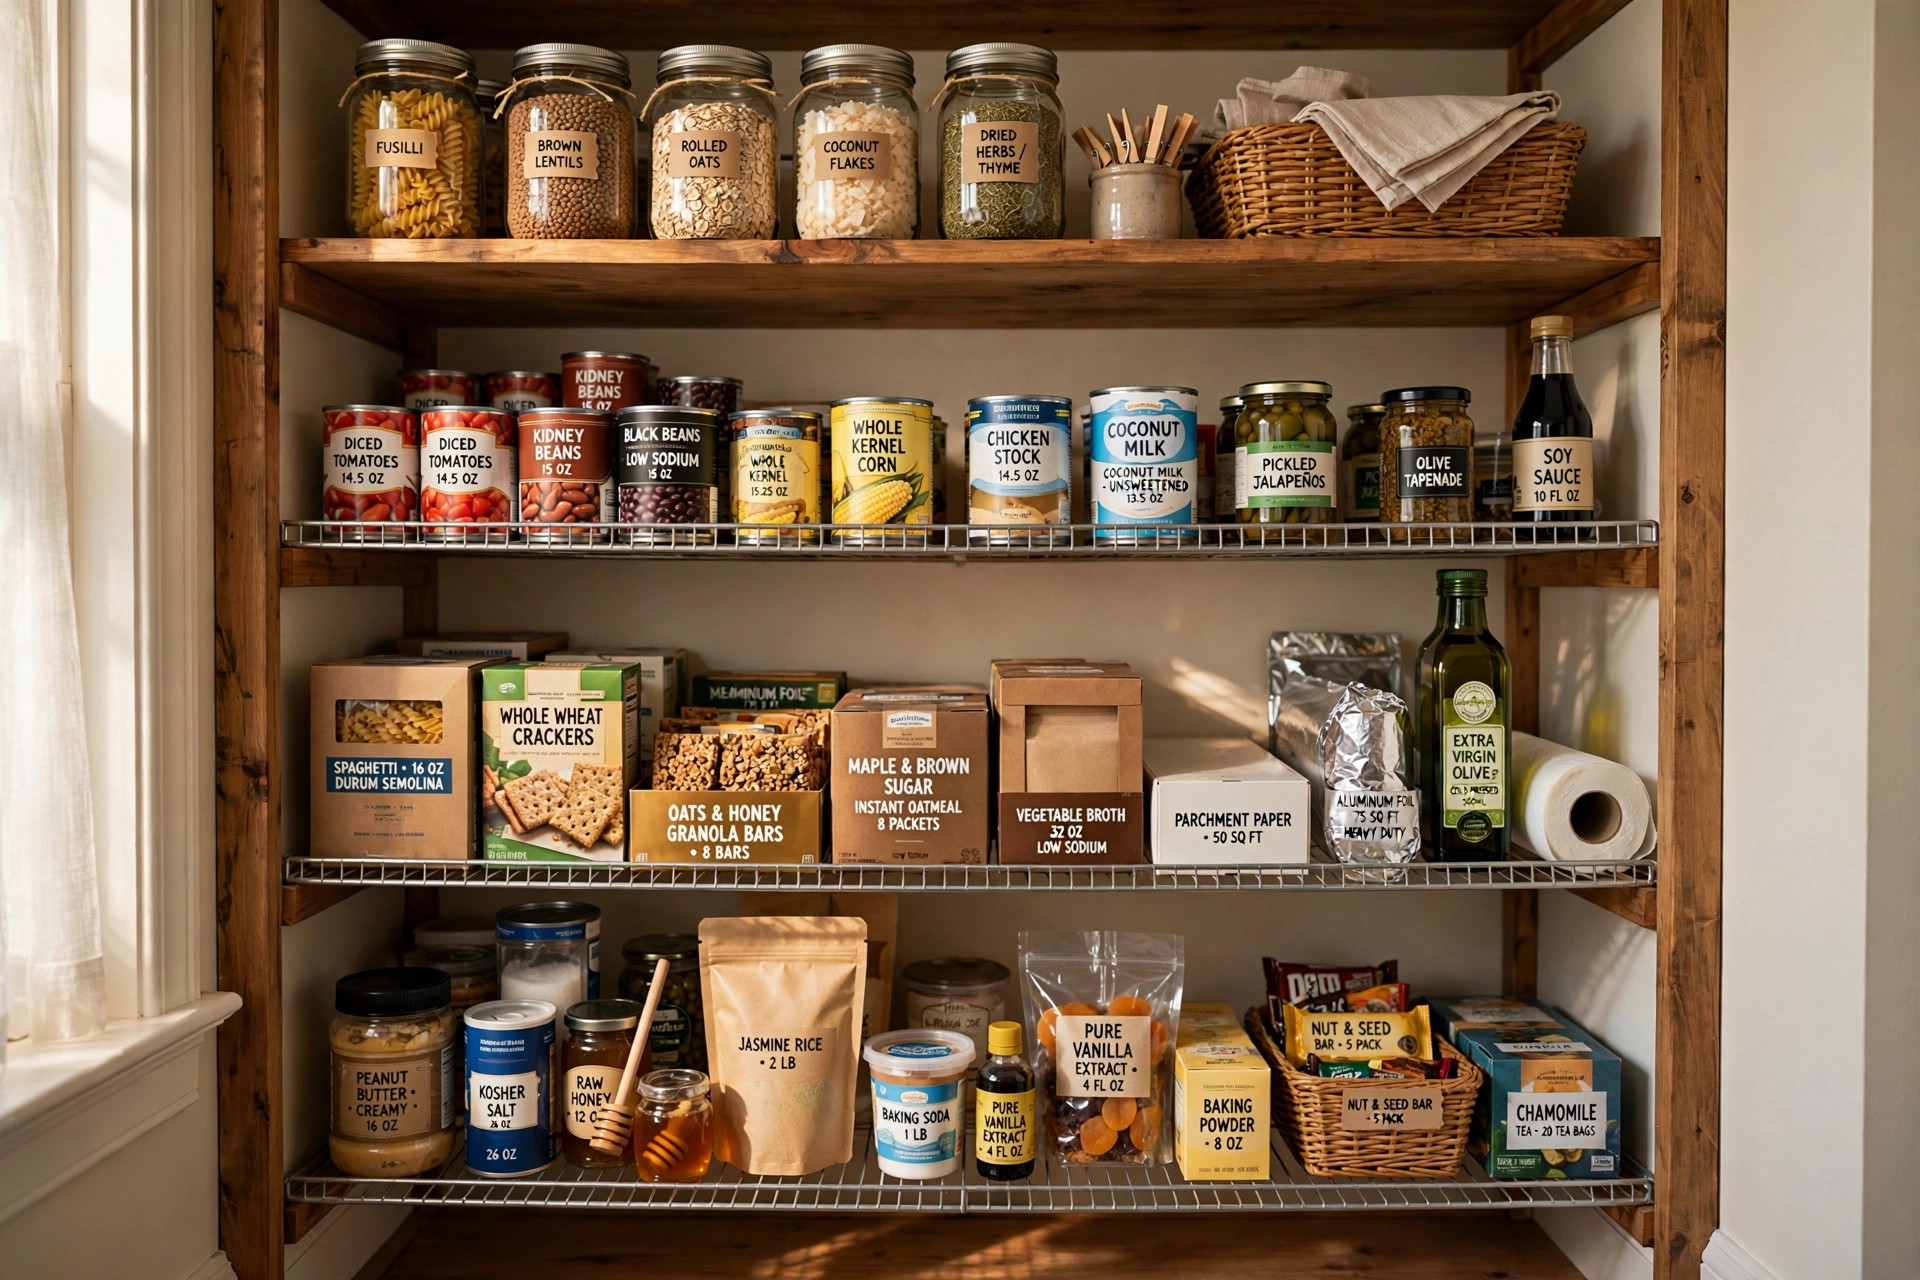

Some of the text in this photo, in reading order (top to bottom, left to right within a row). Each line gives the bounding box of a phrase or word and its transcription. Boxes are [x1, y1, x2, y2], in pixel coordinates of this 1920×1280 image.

[981, 129, 1017, 142] DRIED
[376, 141, 423, 155] FUSILLI
[538, 140, 581, 152] BROWN
[682, 140, 727, 153] ROLLED
[824, 141, 879, 153] COCONUT
[536, 156, 583, 169] LENTILS
[689, 155, 720, 169] OATS
[830, 156, 875, 170] FLAKES
[978, 161, 1021, 174] THYME
[576, 370, 624, 384] KIDNEY
[578, 385, 621, 399] BEANS
[854, 420, 902, 435] WHOLE
[1108, 421, 1180, 438] COCONUT
[533, 429, 584, 443] KIDNEY
[624, 427, 700, 442] BLACK BEANS
[988, 430, 1049, 445] CHICKEN
[345, 438, 382, 450] DICED
[440, 438, 476, 450] DICED
[852, 439, 905, 454] KERNEL
[1125, 440, 1166, 456] MILK
[535, 446, 581, 460] BEANS
[995, 450, 1041, 464] STOCK
[1544, 448, 1572, 464] SOY
[334, 455, 398, 468] TOMATOES
[429, 455, 492, 468] TOMATOES
[627, 453, 699, 467] LOW SODIUM
[858, 457, 896, 472] CORN
[1263, 458, 1317, 471] PICKLED
[1416, 456, 1451, 470] OLIVE
[542, 464, 572, 475] 15 OZ
[660, 469, 672, 479] OZ
[999, 470, 1039, 481] 14.5 OZ
[1104, 467, 1183, 479] COCONUT MILK
[342, 473, 384, 484] 14.5 OZ
[437, 473, 478, 484] 14.5 OZ
[750, 471, 788, 482] KERNEL
[1253, 472, 1325, 489] JALAPEÑOS
[1404, 473, 1462, 488] TAPENADE
[1534, 469, 1581, 484] SAUCE
[776, 487, 788, 496] OZ
[1534, 490, 1579, 502] 10 FL OZ
[1150, 494, 1163, 503] OZ
[500, 708, 603, 724] WHOLE WHEAT
[513, 728, 594, 745] CRACKERS
[1454, 734, 1495, 747] EXTRA
[1453, 751, 1495, 763] VIRGIN
[334, 762, 444, 775] SPAGHETTI 16 OZ
[849, 758, 970, 774] MAPLE & BROWN
[335, 777, 443, 790] DURUM SEMOLINA
[885, 778, 933, 794] SUGAR
[855, 801, 962, 814] INSTANT OATMEAL
[1337, 795, 1393, 808] ALUMINUM
[668, 804, 781, 821] OATS & HONEY
[1017, 808, 1126, 822] VEGETABLE BROTH
[1370, 810, 1383, 823] SQ
[1388, 811, 1399, 824] FT
[878, 817, 939, 830] 8 PACKETS
[1175, 813, 1291, 827] PARCHMENT PAPER
[667, 825, 783, 842] GRANOLA BARS
[1050, 826, 1082, 838] 32 OZ
[1213, 831, 1263, 844] 50 SQ FT
[1345, 827, 1406, 840] HEAVY DUTY
[703, 846, 749, 859] 8 BARS
[1037, 841, 1107, 854] LOW SODIUM
[1085, 1023, 1122, 1039] PURE
[1312, 1021, 1391, 1035] NUT & SEED
[739, 1037, 823, 1051] JASMINE RICE
[1073, 1042, 1133, 1059] VANILLA
[1315, 1039, 1381, 1050] BAR 5 PACK
[770, 1057, 796, 1069] 2 LB
[1076, 1062, 1128, 1076] EXTRACT
[357, 1071, 408, 1085] PEANUT
[577, 1076, 603, 1089] RAW
[1083, 1080, 1124, 1091] 4 FL OZ
[357, 1087, 407, 1101] BUTTER
[480, 1085, 525, 1100] KOSHER
[572, 1092, 611, 1106] HONEY
[356, 1103, 407, 1116] CREAMY
[488, 1103, 516, 1117] SALT
[993, 1101, 1019, 1114] PURE
[1204, 1099, 1252, 1113] BAKING
[1348, 1098, 1432, 1111] NUT & SEED BAR
[575, 1111, 585, 1122] 12
[883, 1107, 949, 1124] BAKING SODA
[1374, 1113, 1379, 1123] 5
[1517, 1104, 1596, 1121] CHAMOMILE
[367, 1120, 399, 1131] 16 OZ
[984, 1115, 1026, 1129] VANILLA
[1200, 1118, 1254, 1132] POWDER
[904, 1128, 927, 1141] 1 LB
[984, 1129, 1026, 1144] EXTRACT
[1516, 1126, 1595, 1136] TEA 20 TEA BAGS
[1215, 1137, 1242, 1150] 8 OZ
[487, 1149, 517, 1160] 26 OZ
[997, 1146, 1007, 1157] FL
[1011, 1145, 1023, 1157] OZ
